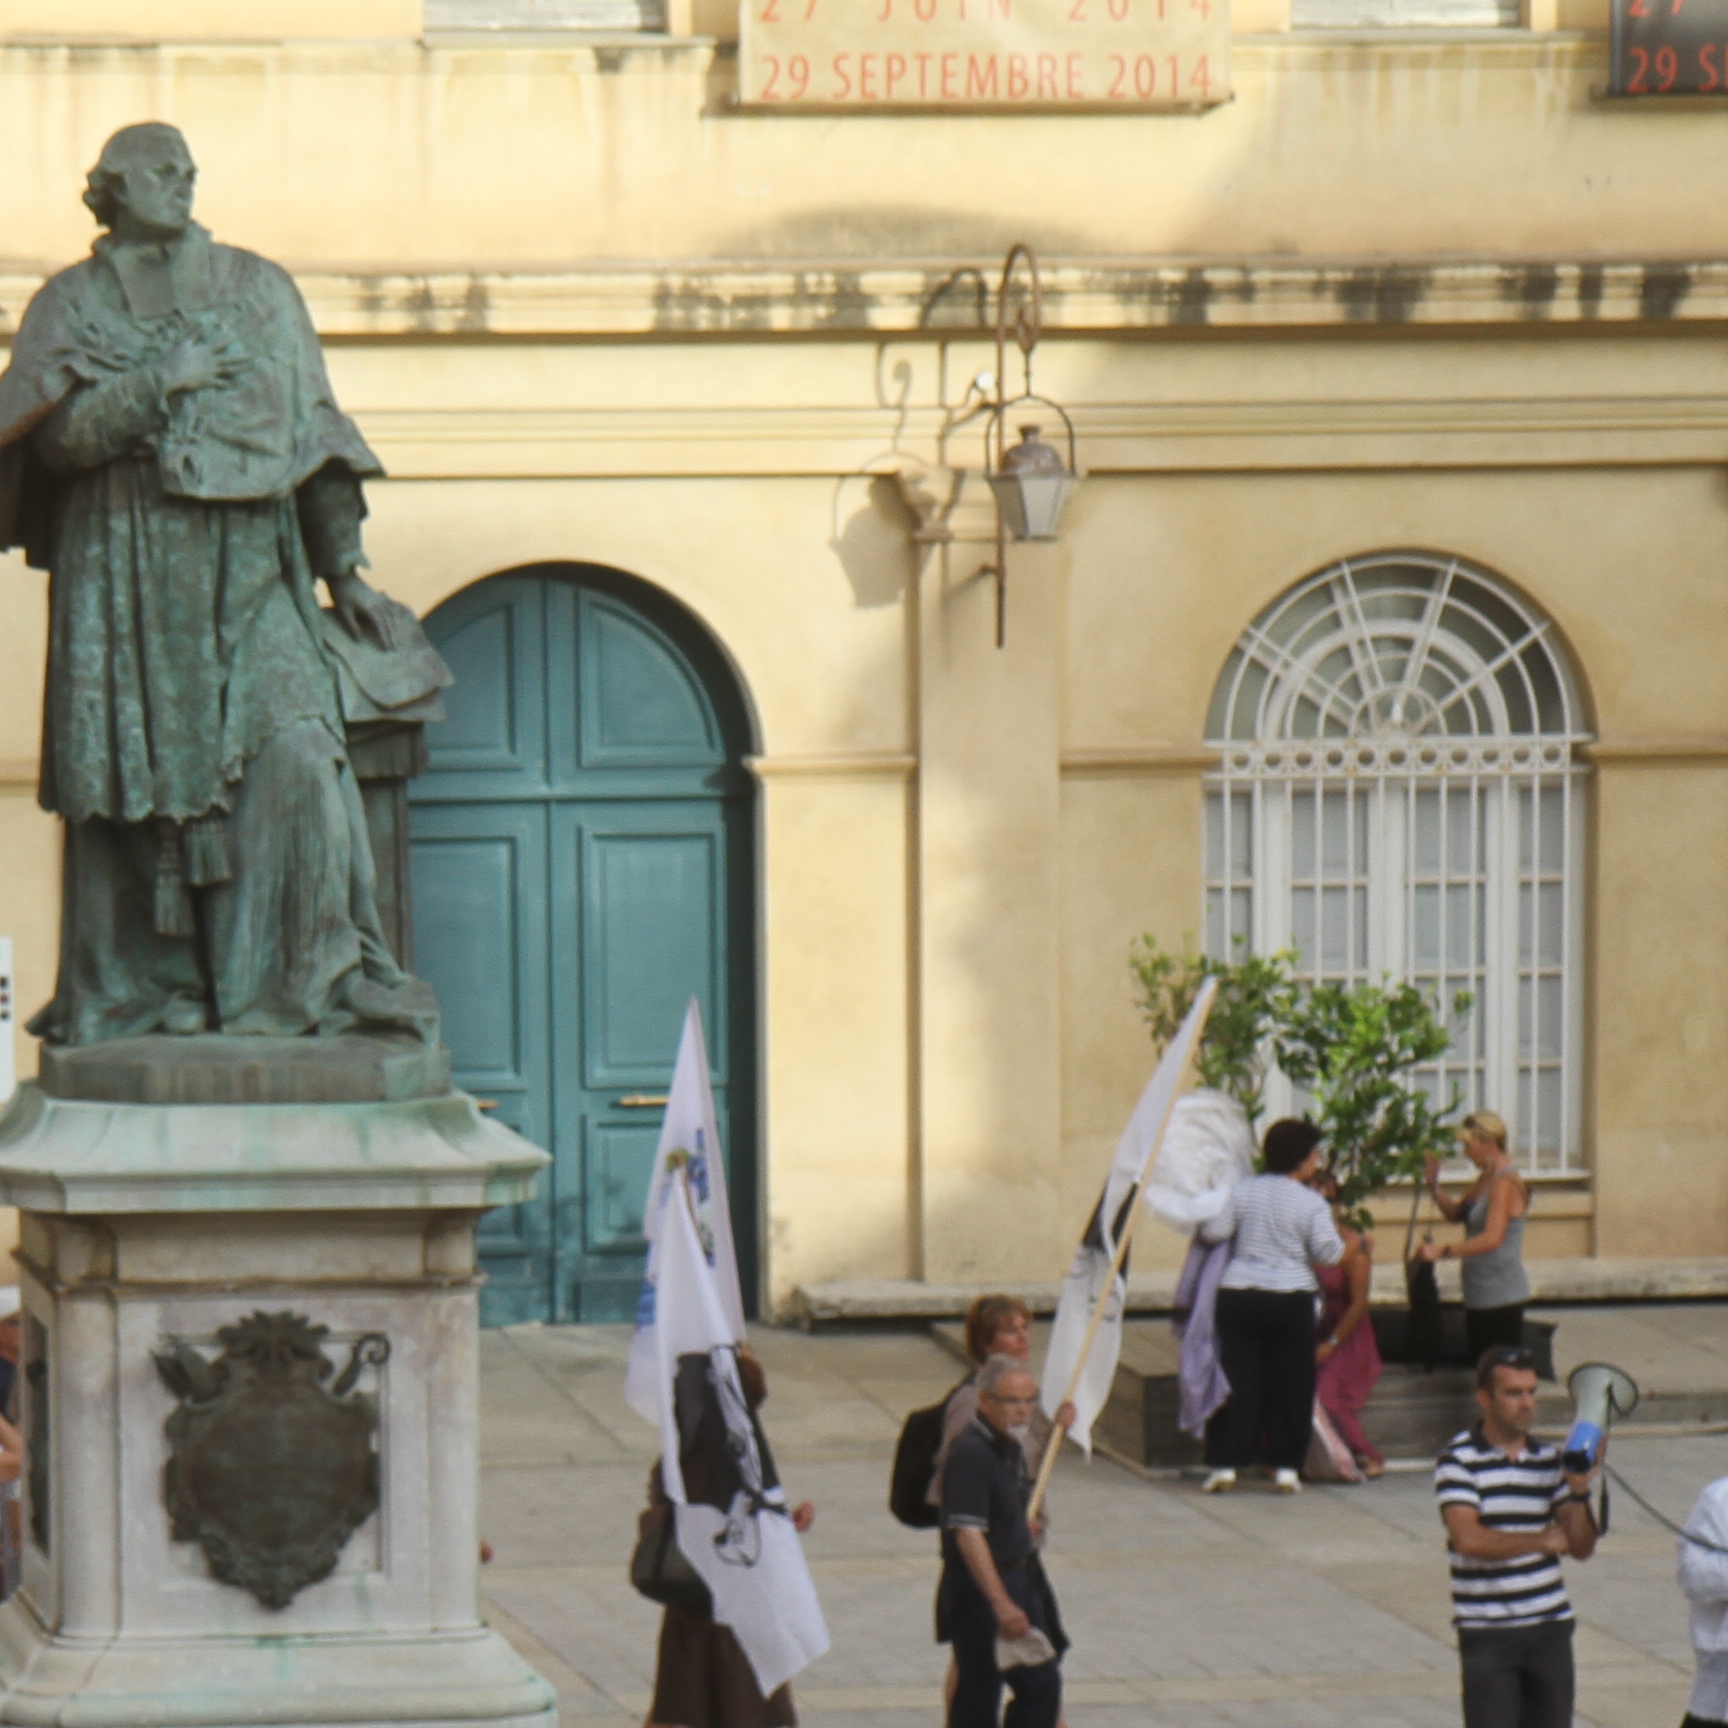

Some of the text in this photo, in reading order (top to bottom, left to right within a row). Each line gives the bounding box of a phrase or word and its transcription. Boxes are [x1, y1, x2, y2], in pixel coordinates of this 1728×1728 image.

[759, 51, 1212, 101] 29 SEPTEMBRE 2014
[1627, 45, 1680, 93] 29
